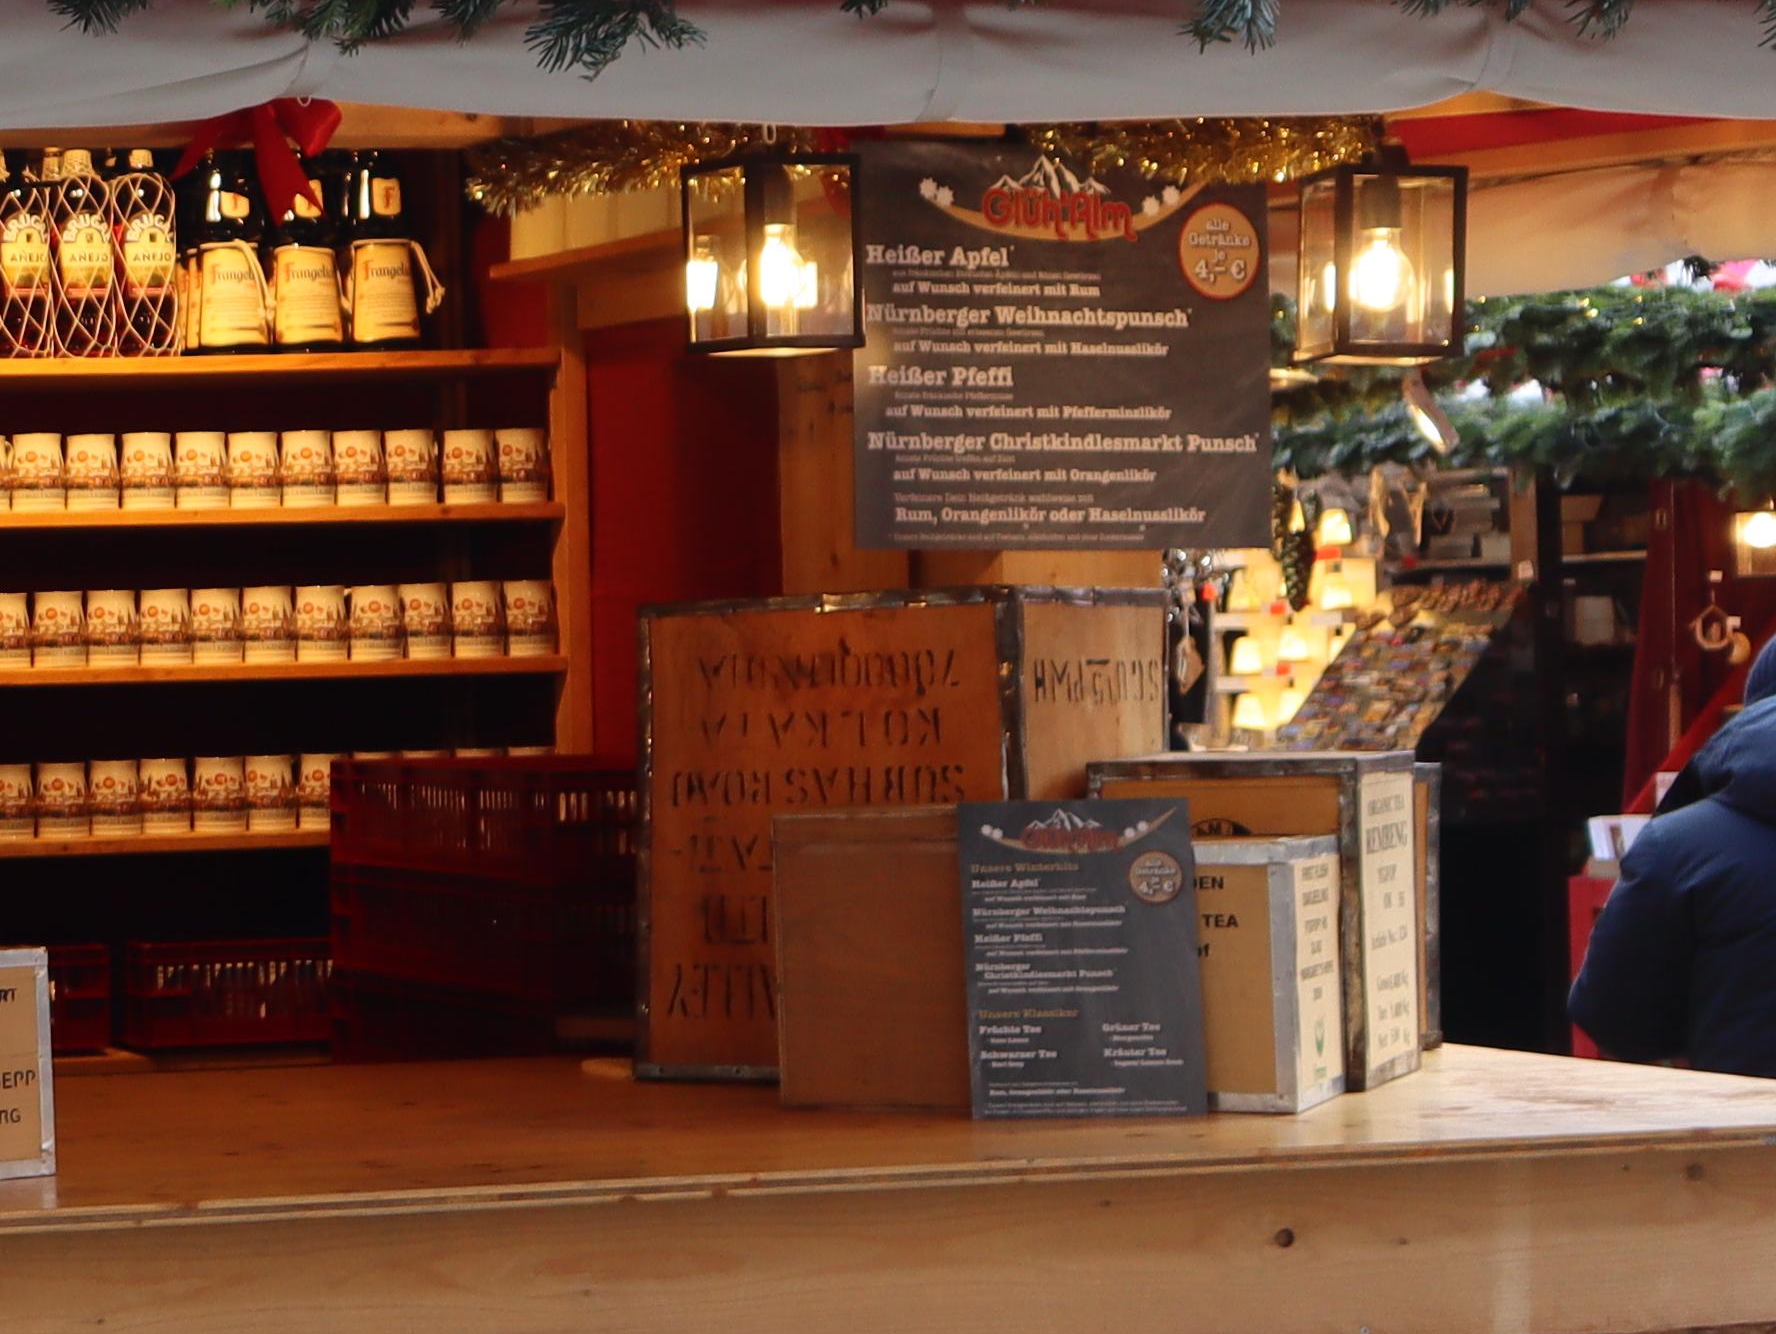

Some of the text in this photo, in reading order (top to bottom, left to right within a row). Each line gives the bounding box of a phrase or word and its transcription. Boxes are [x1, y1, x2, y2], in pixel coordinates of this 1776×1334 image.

[1206, 218, 1229, 230] alle
[1189, 234, 1250, 246] Getränke
[866, 244, 945, 265] Heißer
[1213, 250, 1225, 262] je
[866, 304, 990, 327] Nürnberger
[868, 432, 985, 453] Nürnberger
[990, 432, 1183, 451] Christkindlesmarkt
[895, 506, 1206, 524] Rum, Orangenlikör oder Haselnusslikör
[1203, 914, 1239, 928] TEA
